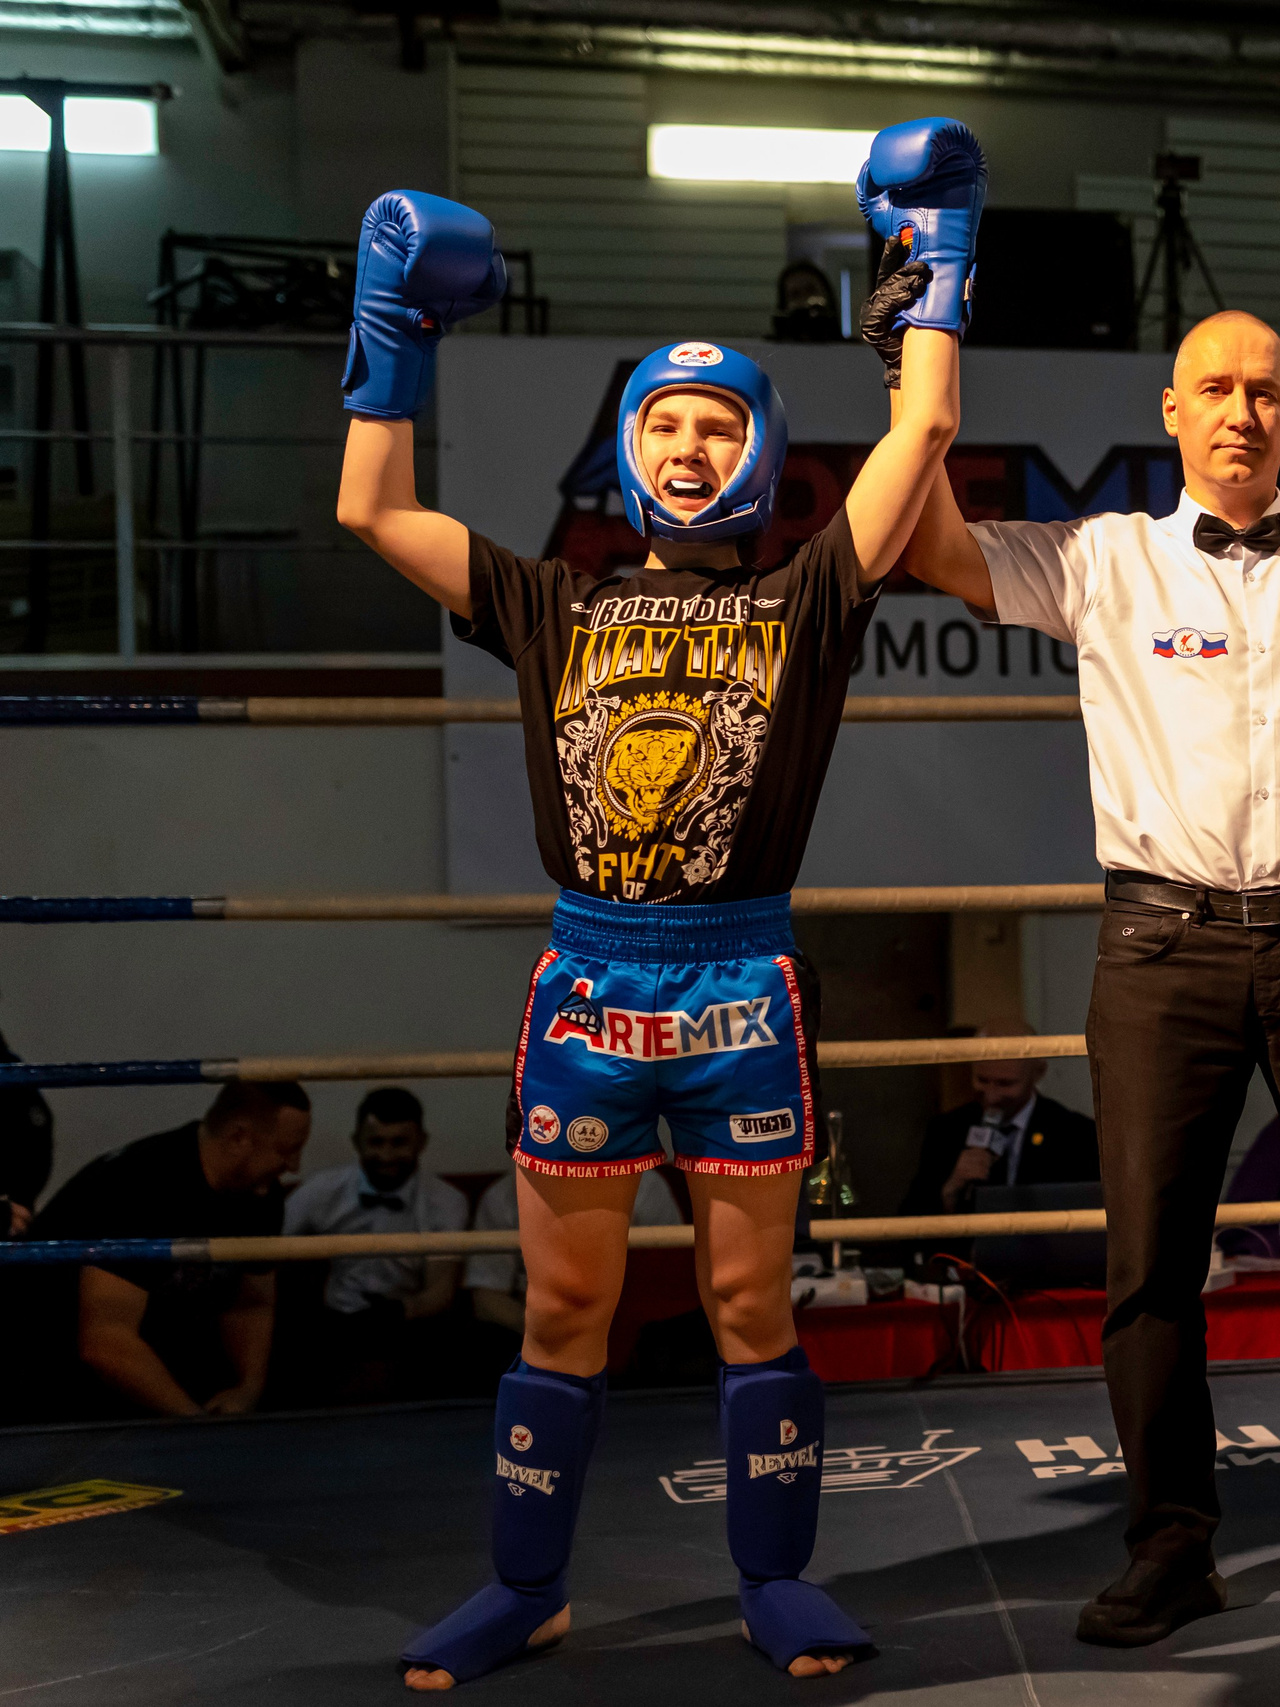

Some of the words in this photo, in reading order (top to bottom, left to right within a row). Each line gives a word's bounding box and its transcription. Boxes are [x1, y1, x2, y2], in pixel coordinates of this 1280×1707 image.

[594, 595, 679, 632] BORN
[554, 625, 682, 720] MUAY
[684, 621, 787, 713] THAI
[781, 961, 796, 989] THAI
[544, 978, 778, 1061] ARTEMIX
[790, 992, 801, 1022] MUAY
[795, 1025, 806, 1053] THAI
[800, 1056, 810, 1086] MUAY
[802, 1089, 812, 1116] THAI
[804, 1121, 814, 1151] MUAY
[534, 1160, 563, 1176] THAI
[567, 1166, 599, 1177] MUAY
[603, 1165, 631, 1176] THAI
[694, 1162, 720, 1175] MUAY
[723, 1163, 749, 1176] THAI
[751, 1162, 782, 1177] MUAY
[786, 1154, 812, 1172] THAI
[747, 1443, 817, 1479] REYVEL
